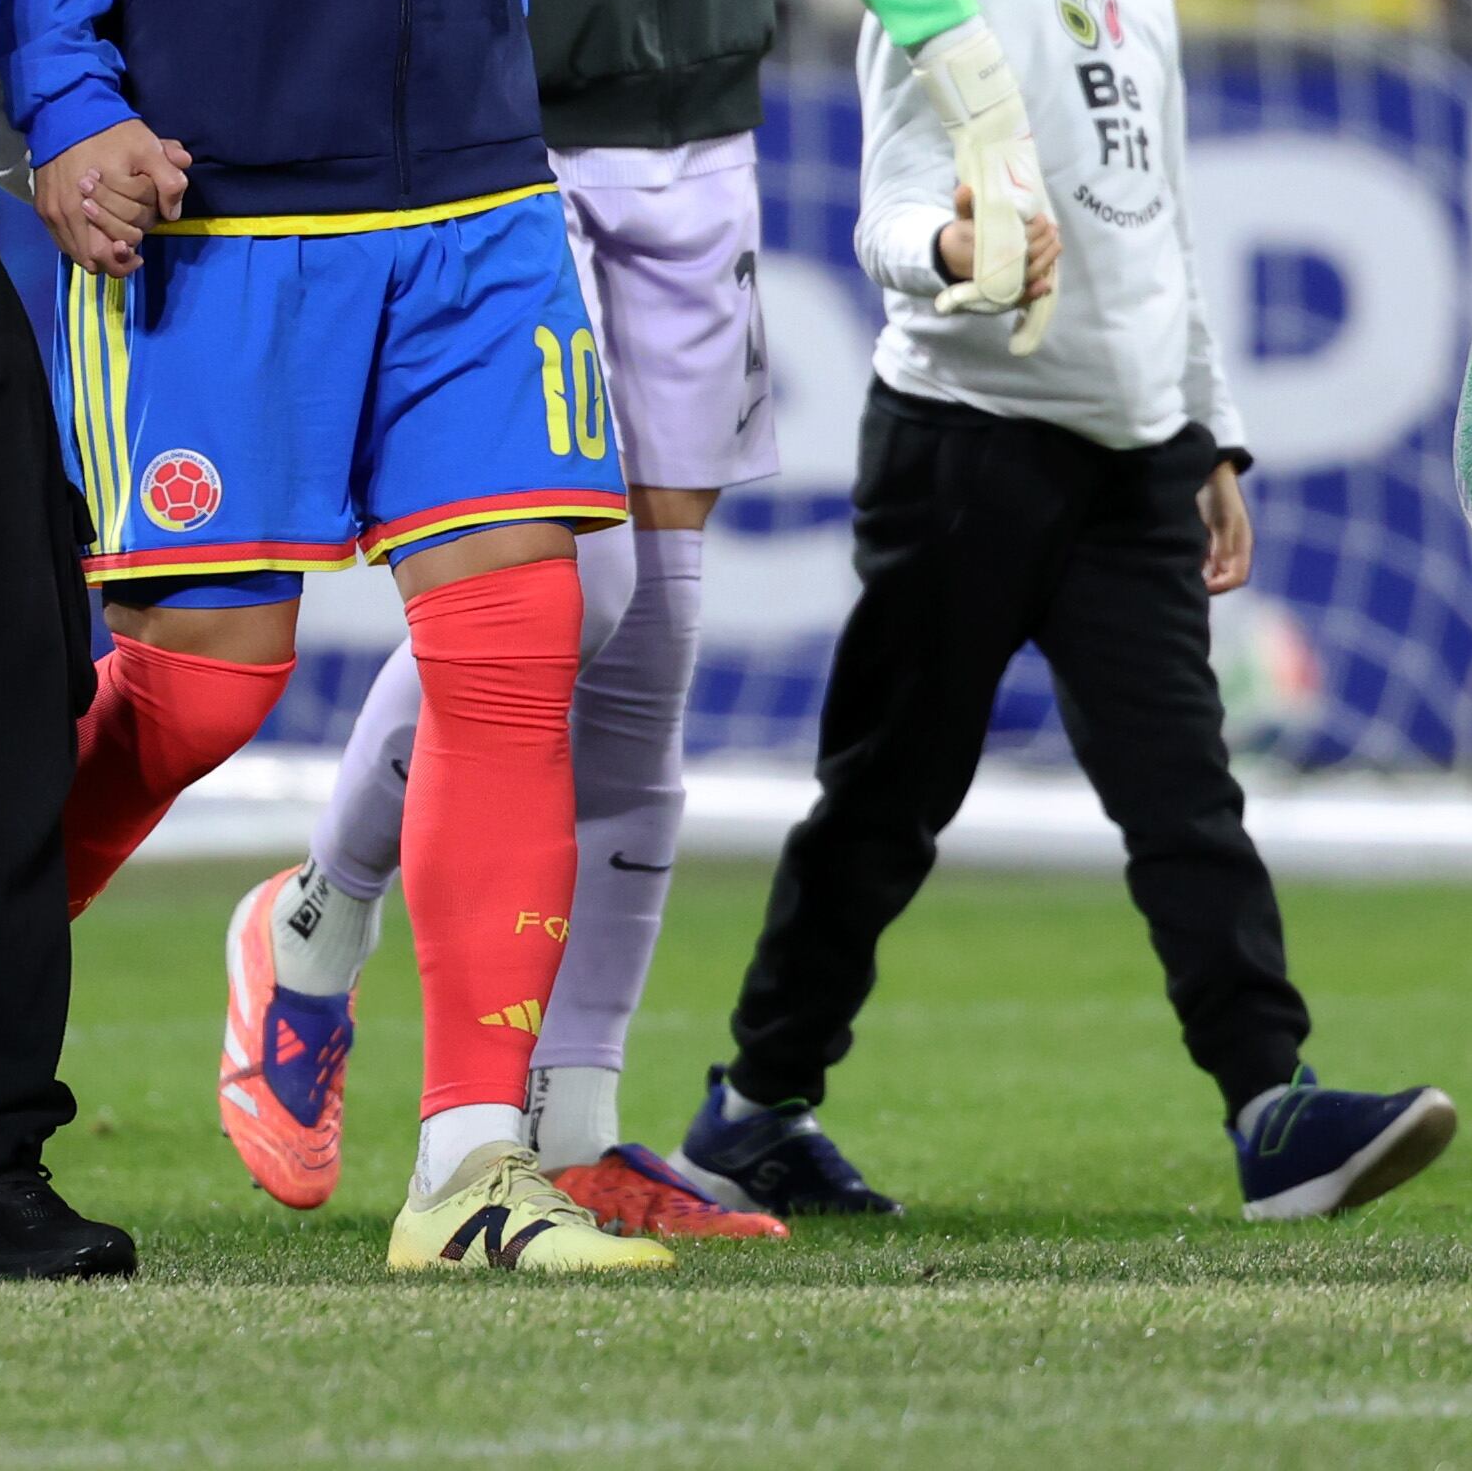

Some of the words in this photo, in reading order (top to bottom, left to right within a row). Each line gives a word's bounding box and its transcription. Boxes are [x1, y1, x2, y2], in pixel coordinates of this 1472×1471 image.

[1075, 61, 1142, 111] Be
[1094, 116, 1150, 172] Fit
[534, 325, 606, 460] 10
